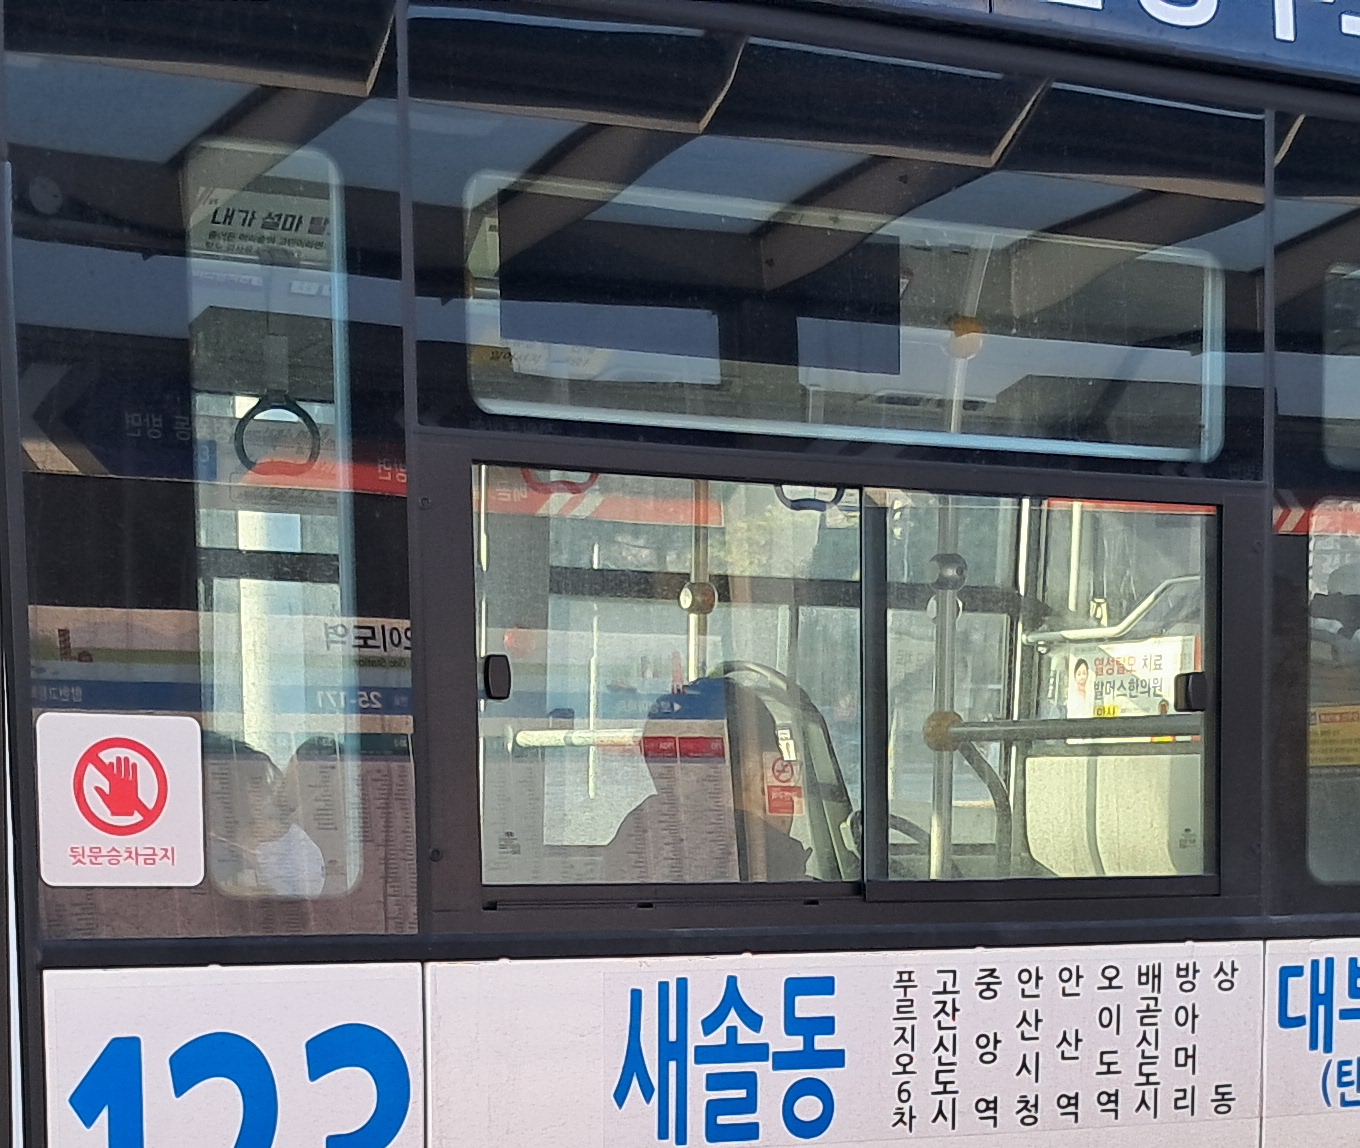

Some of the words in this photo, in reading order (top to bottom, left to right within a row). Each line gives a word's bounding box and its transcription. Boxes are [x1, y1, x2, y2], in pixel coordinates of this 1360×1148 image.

[1094, 677, 1164, 701] 발머스한의원
[1142, 654, 1163, 672] 치료
[68, 845, 177, 867] 뒷문승차금지
[613, 975, 846, 1146] 새솔동
[891, 970, 918, 1133] 푸르지오6차
[931, 969, 960, 1131] 고잔신도시
[974, 968, 1002, 1128] 중앙역
[1015, 966, 1044, 1127] 안산시청
[1056, 964, 1084, 1124] 안산역
[1095, 965, 1124, 1120] 오이도역
[1134, 962, 1162, 1119] 배곧신도시
[1173, 961, 1200, 1117] 방아머리
[1210, 960, 1239, 1115] 상동
